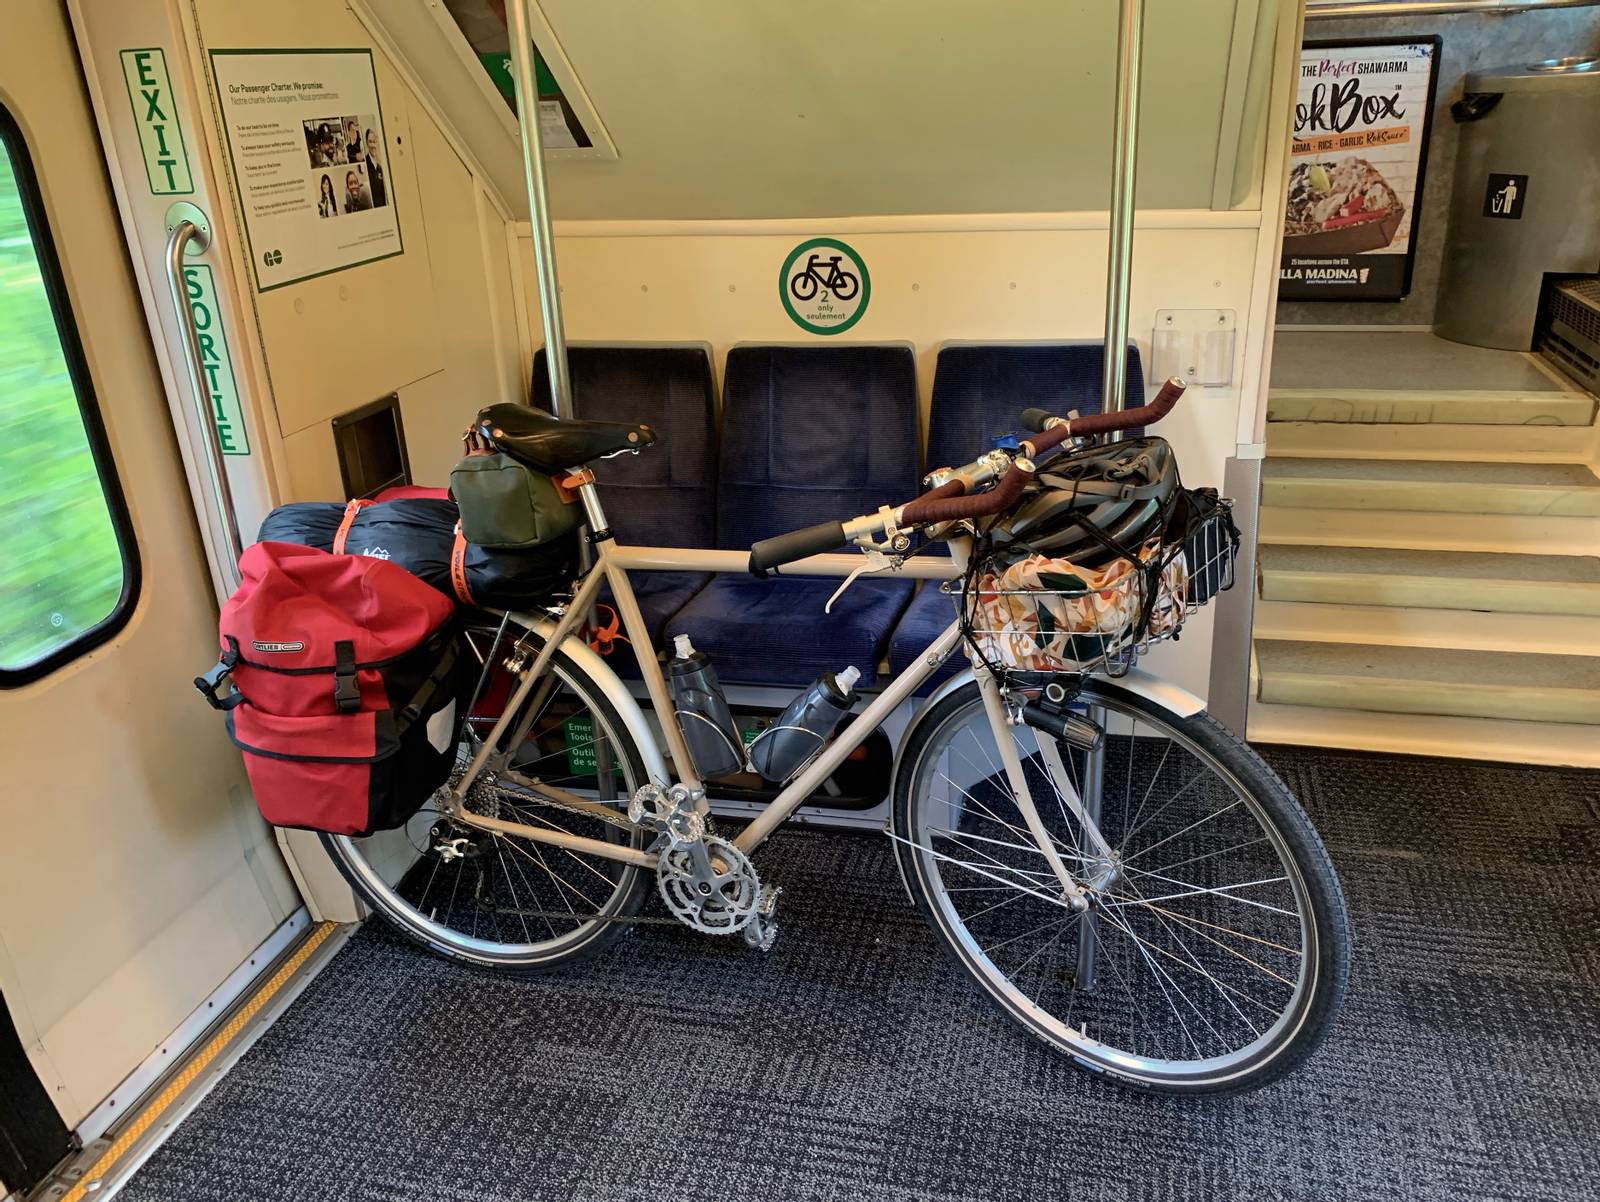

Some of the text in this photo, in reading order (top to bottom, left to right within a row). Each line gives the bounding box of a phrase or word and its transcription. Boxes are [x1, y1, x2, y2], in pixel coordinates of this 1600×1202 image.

[1302, 59, 1408, 78] THE Perfect SHAWARMA
[134, 52, 177, 190] EXIT
[1318, 140, 1333, 150] RICE
[1340, 136, 1364, 148] GARLIC
[1305, 268, 1358, 279] MADINA
[820, 289, 830, 303] 2
[817, 304, 834, 312] only
[806, 312, 846, 320] seulement
[183, 269, 236, 451] SORTIE
[568, 723, 592, 732] Emer
[570, 733, 594, 741] Tools
[572, 748, 595, 757] Outil
[573, 758, 585, 766] de
